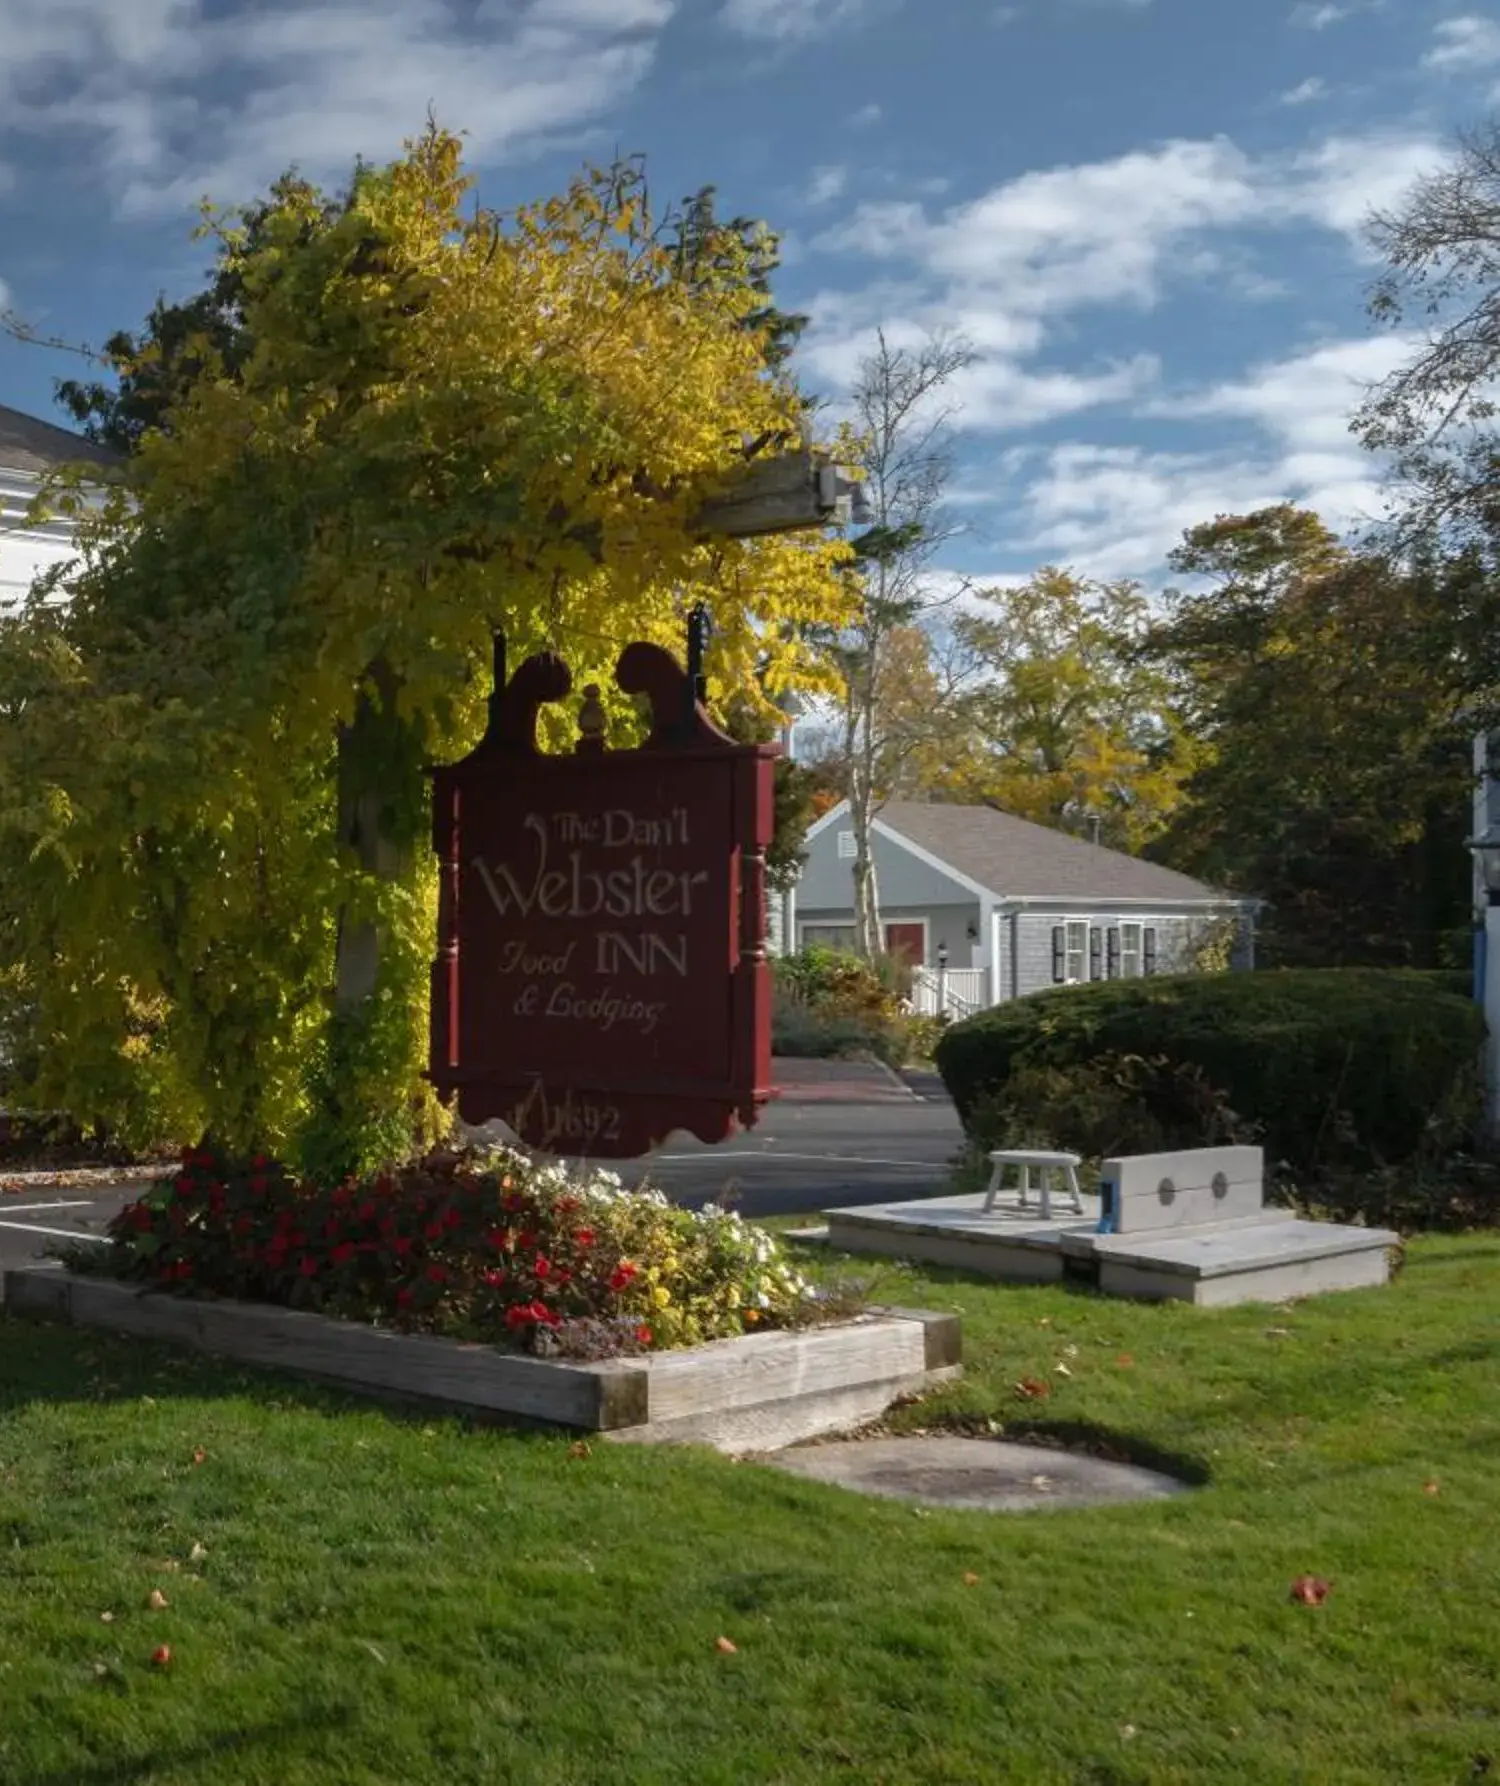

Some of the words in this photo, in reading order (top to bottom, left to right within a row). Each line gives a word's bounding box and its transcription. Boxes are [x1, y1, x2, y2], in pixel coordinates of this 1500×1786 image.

[553, 812, 601, 844] The
[602, 807, 690, 847] Dan'l
[471, 812, 708, 918] Webster
[499, 940, 578, 975] Food
[594, 931, 688, 977] INN
[513, 984, 539, 1016] &
[545, 981, 667, 1035] Lodging
